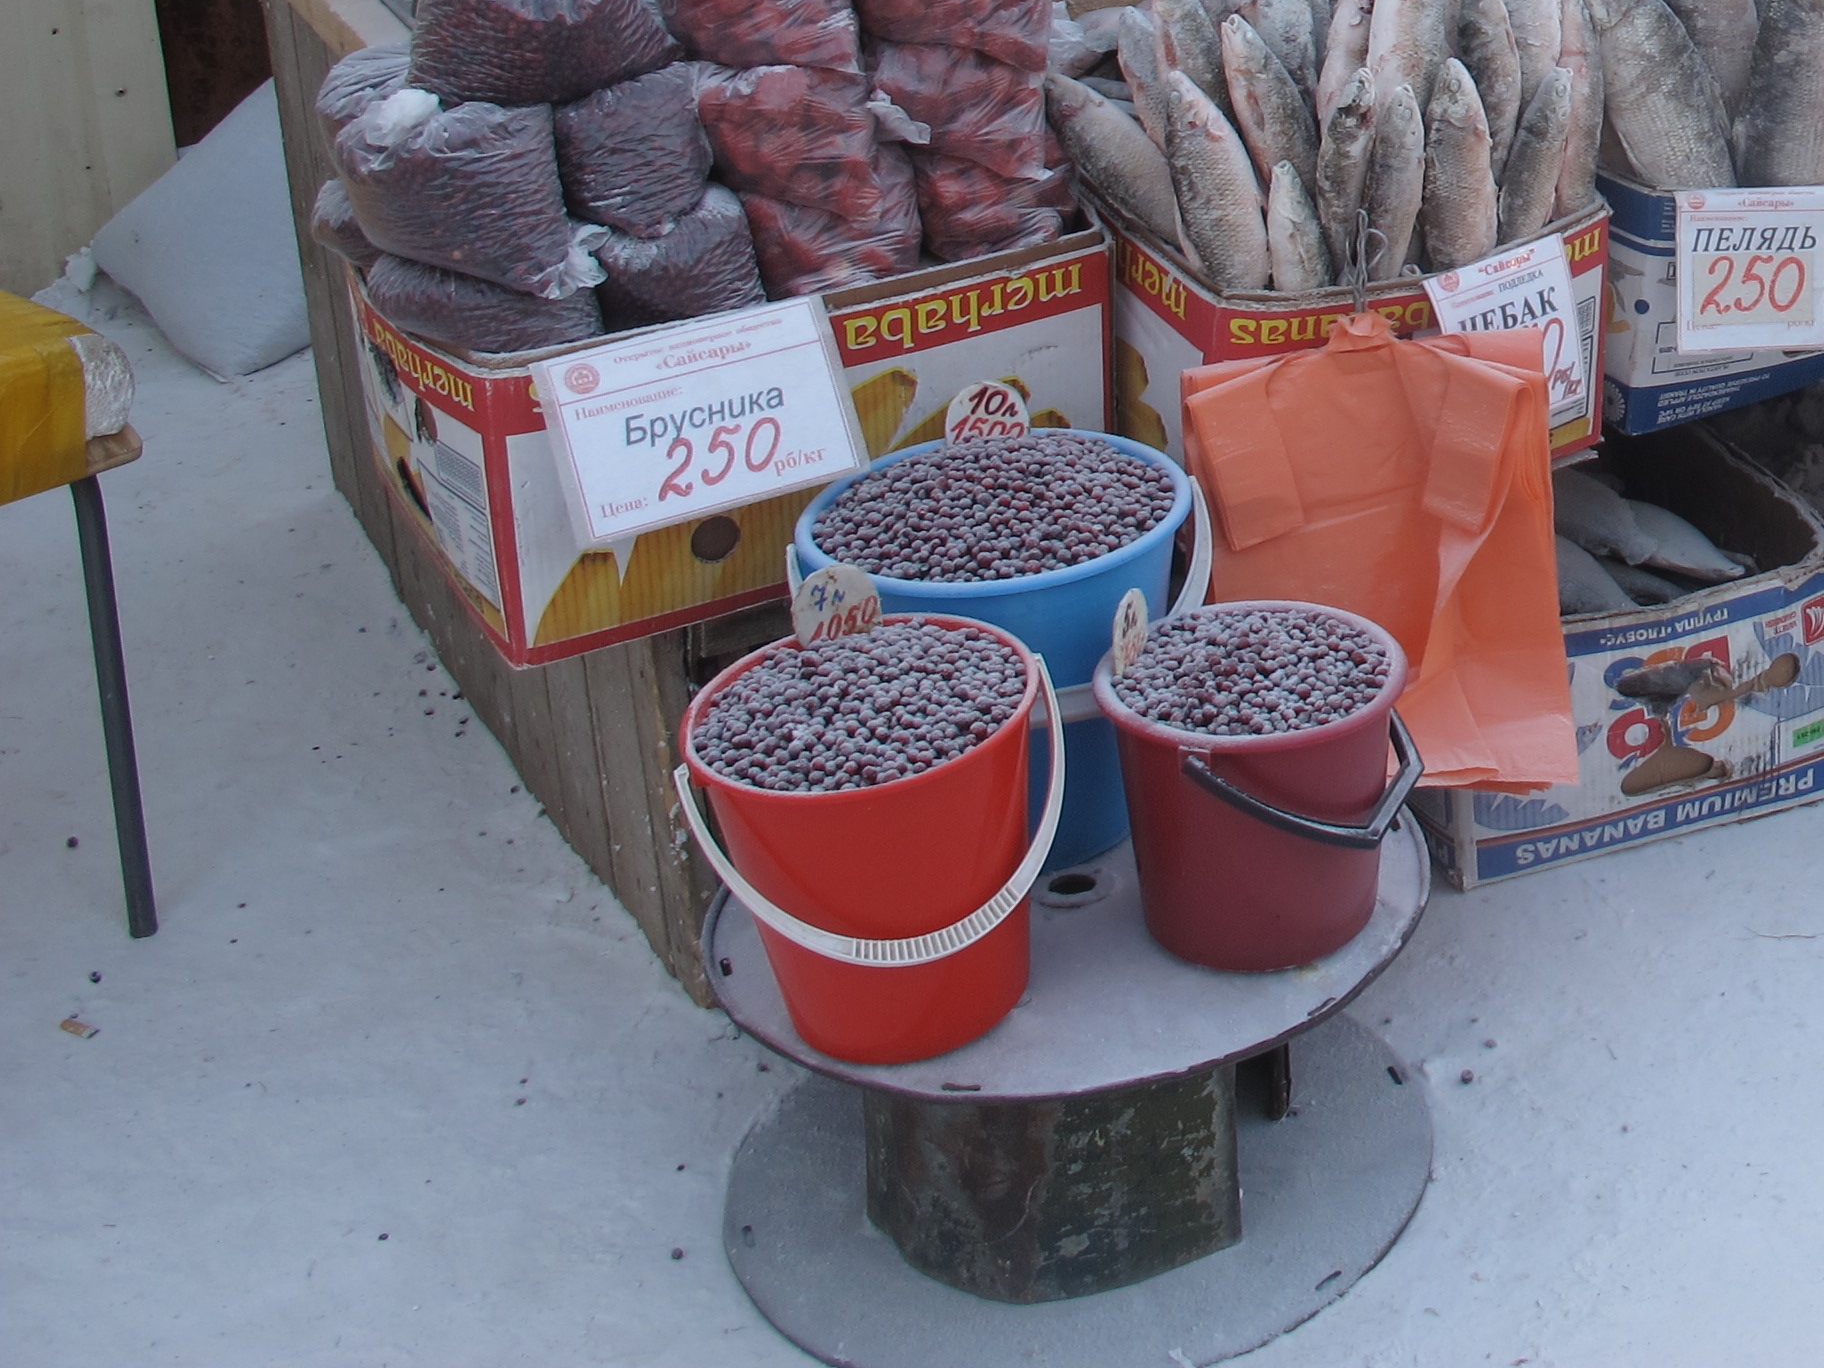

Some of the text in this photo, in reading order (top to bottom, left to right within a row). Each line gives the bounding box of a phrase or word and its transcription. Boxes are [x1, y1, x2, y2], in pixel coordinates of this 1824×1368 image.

[1691, 225, 1817, 253] ПЕЛЯДЬ
[843, 262, 1083, 350] merhaba
[1699, 254, 1806, 316] 250
[373, 318, 476, 413] merhaba
[655, 340, 753, 371] «Сайсары»
[574, 385, 684, 421] Наименование:
[624, 385, 785, 447] Брусника
[599, 446, 827, 520] Цена: рб/кг
[657, 416, 782, 503] 250
[1674, 607, 1729, 632] ГРУППА
[1515, 767, 1815, 866] PREMIUM BANANAS
